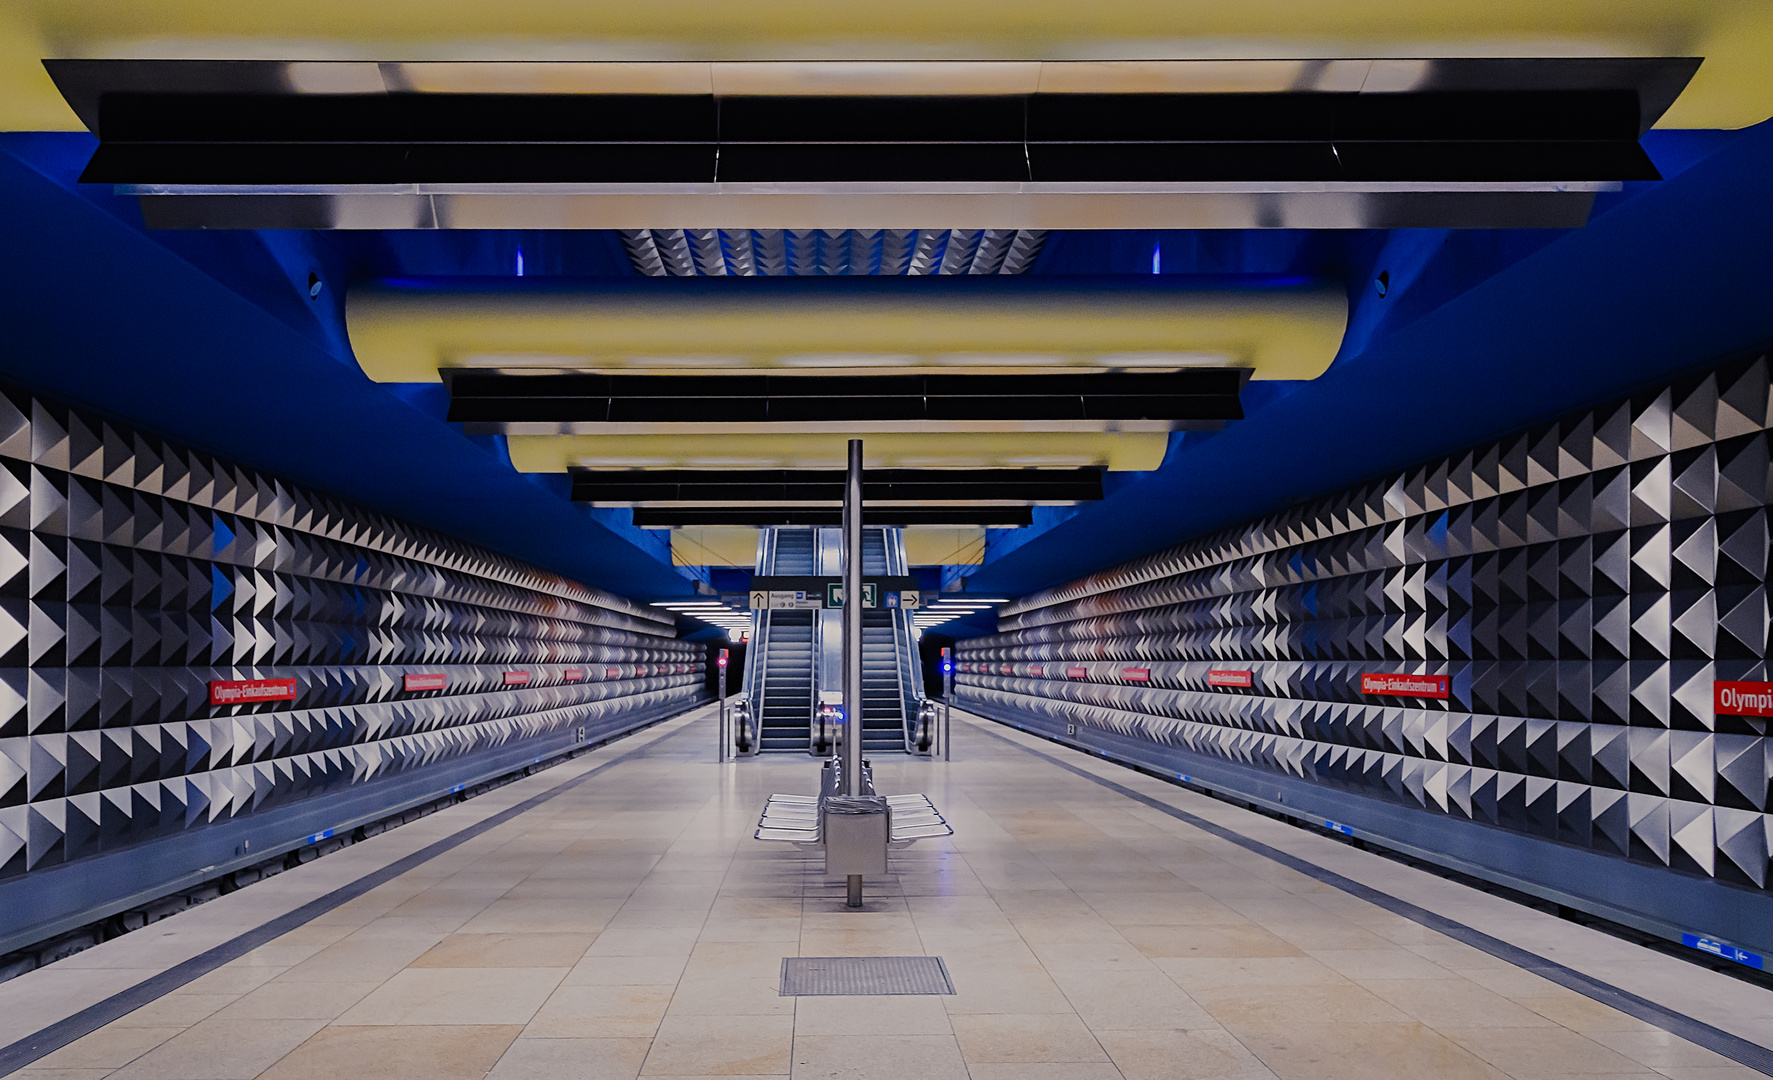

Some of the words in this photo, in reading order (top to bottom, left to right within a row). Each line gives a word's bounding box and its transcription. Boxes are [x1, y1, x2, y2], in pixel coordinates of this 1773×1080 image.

[214, 683, 288, 702] Olympia-Einkaufszentrum
[1363, 677, 1438, 693] Olympia-Einkaufszentrum
[1721, 688, 1773, 713] Olympi
